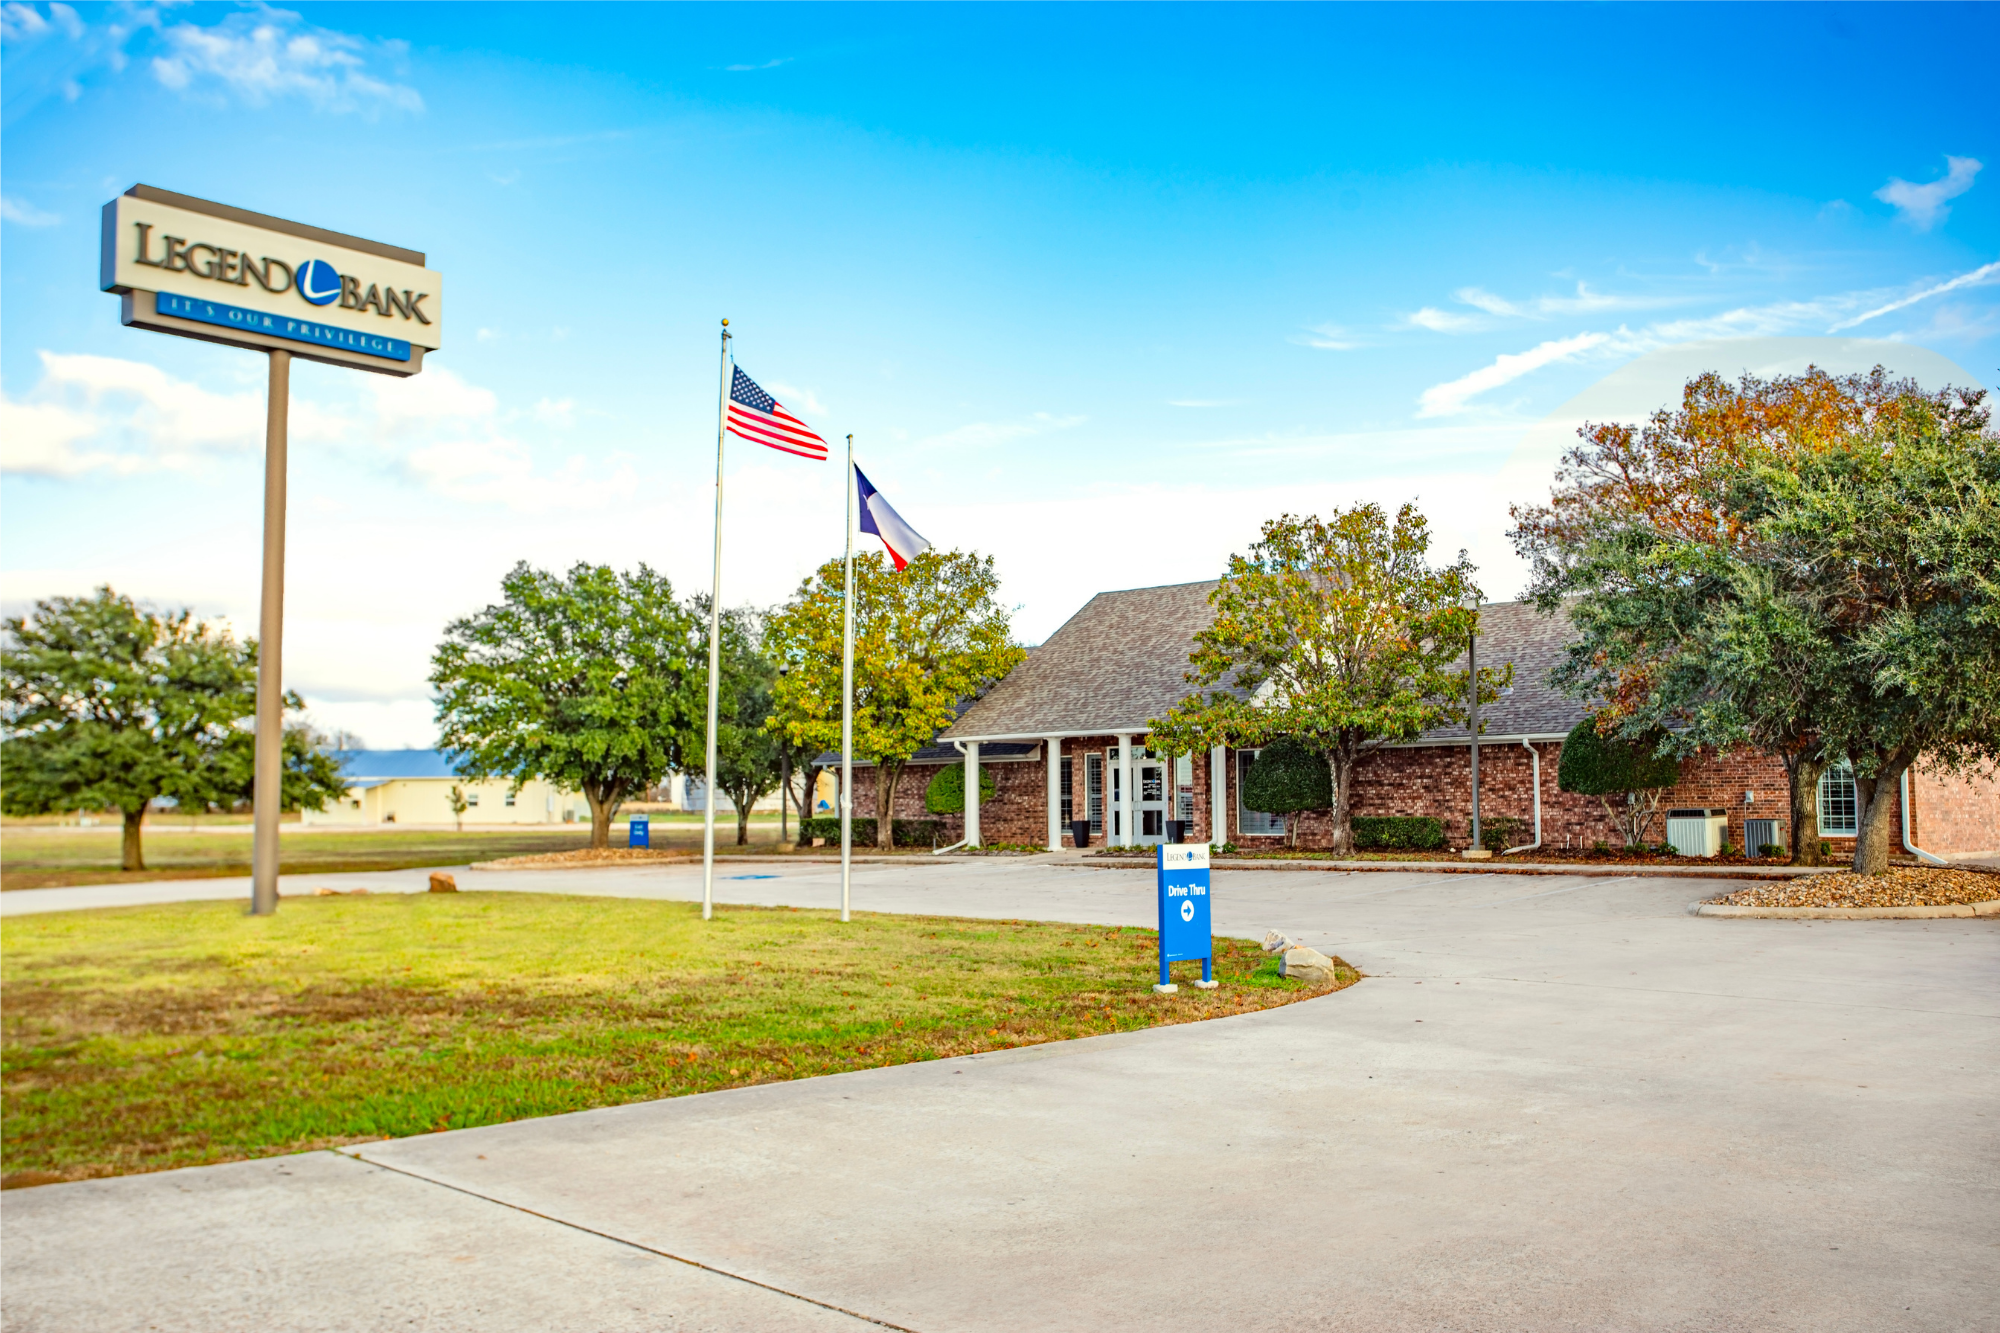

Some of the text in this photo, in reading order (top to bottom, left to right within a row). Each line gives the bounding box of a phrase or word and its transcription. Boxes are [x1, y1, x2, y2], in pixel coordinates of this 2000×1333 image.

[135, 221, 297, 294] LEGEND
[338, 273, 432, 325] BANK
[171, 296, 215, 318] IT'S
[228, 308, 274, 330] OUR
[1167, 852, 1205, 861] LEGEND BANK
[1168, 883, 1206, 897] Drive Thru
